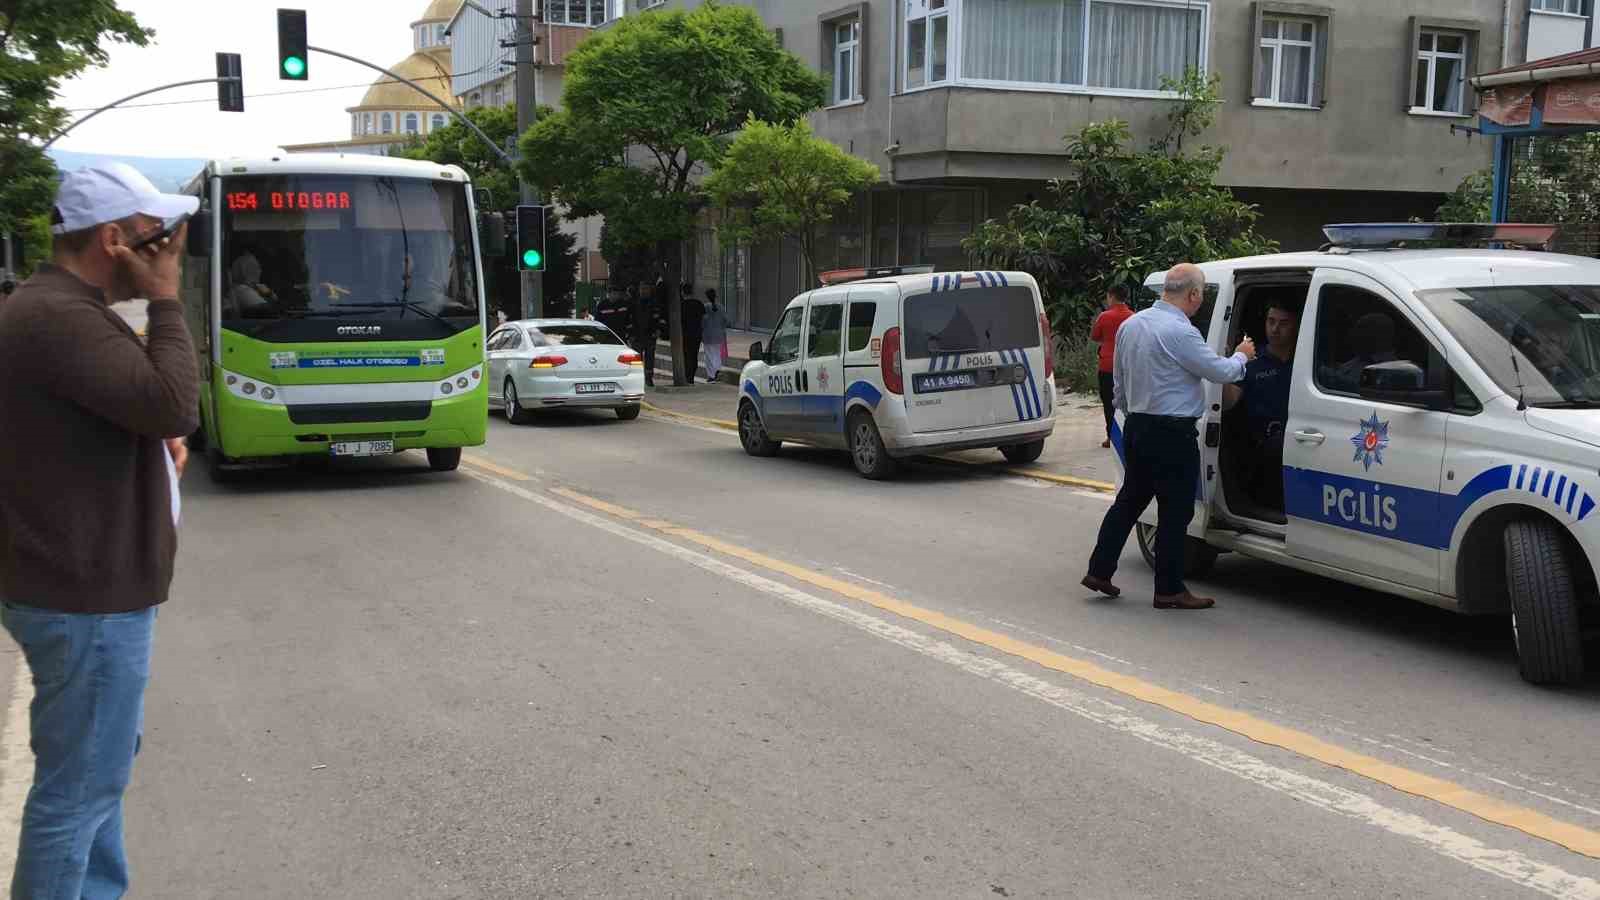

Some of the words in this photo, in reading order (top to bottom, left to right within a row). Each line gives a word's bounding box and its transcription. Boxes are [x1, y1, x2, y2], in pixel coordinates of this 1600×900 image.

[226, 191, 257, 209] 154
[271, 191, 351, 209] OTOGAR
[336, 325, 382, 335] OTOKAR
[923, 378, 936, 388] 41
